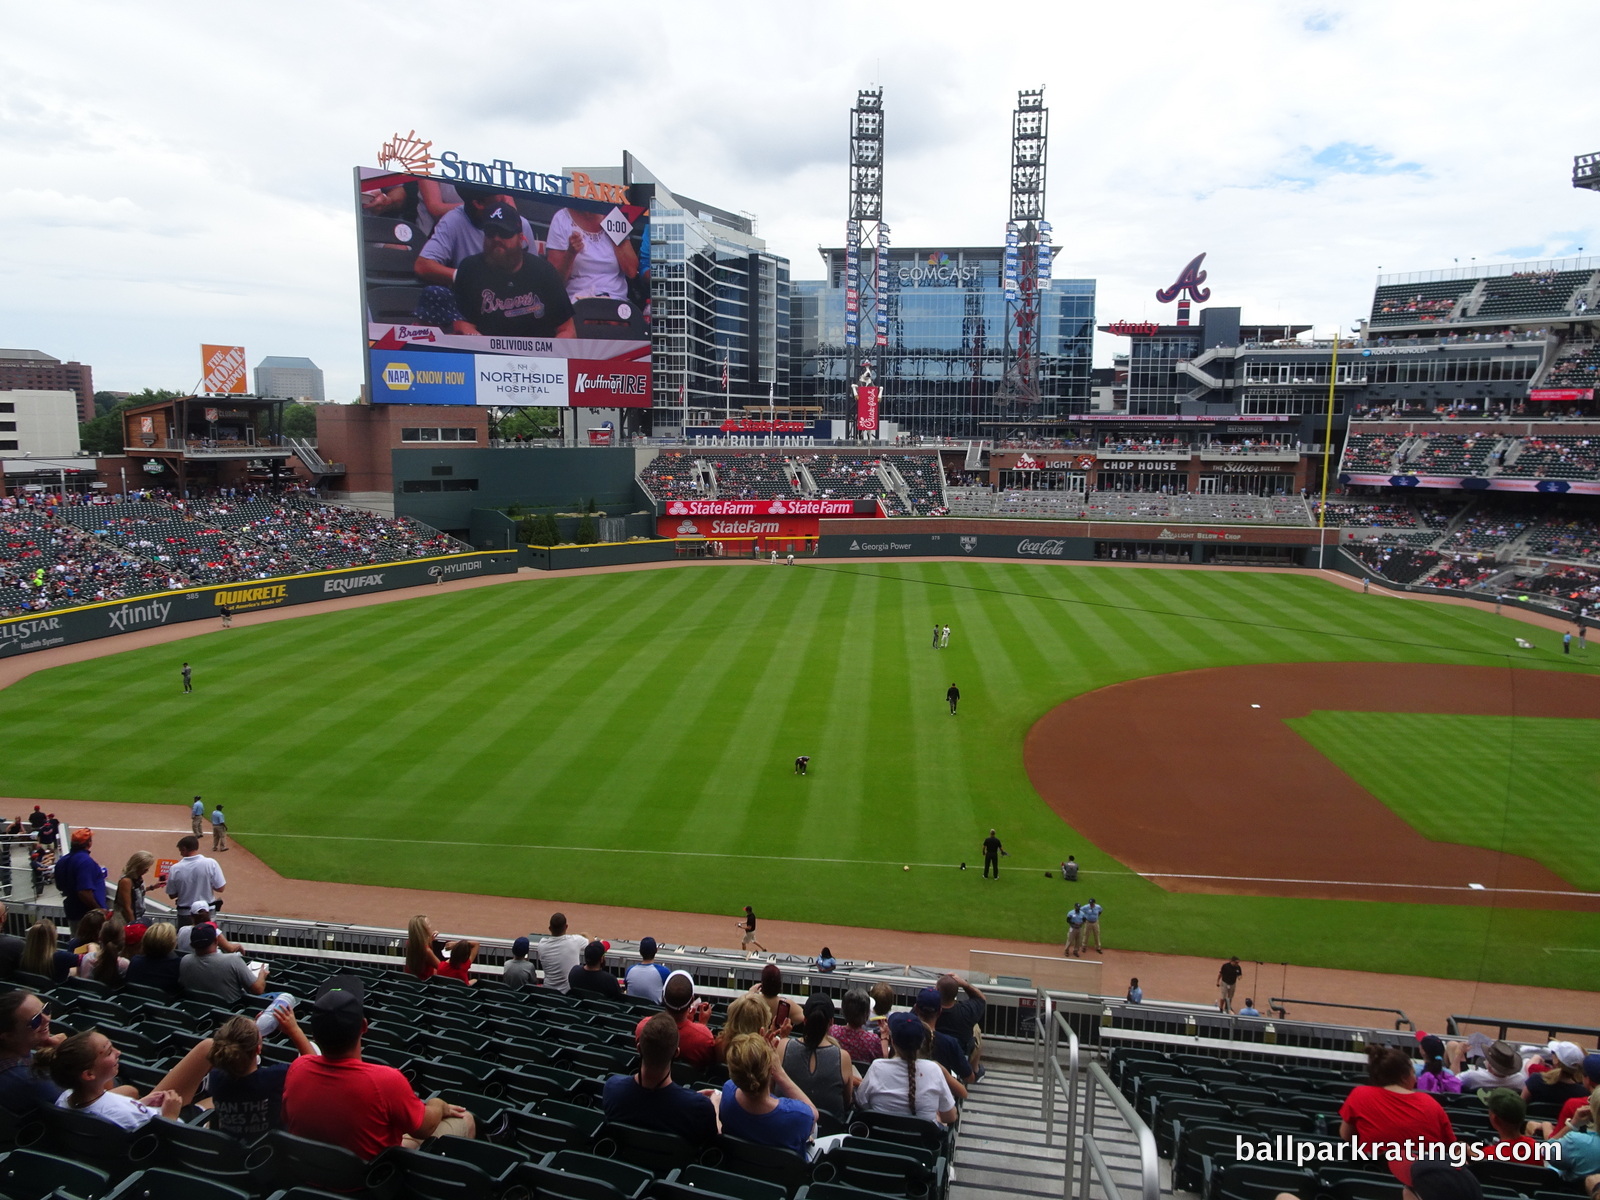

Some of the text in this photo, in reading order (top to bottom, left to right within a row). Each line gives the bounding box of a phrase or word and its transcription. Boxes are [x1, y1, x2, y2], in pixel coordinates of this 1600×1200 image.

[571, 171, 631, 205] PARK
[606, 219, 627, 234] 0:00
[898, 267, 980, 281] COMCAST
[481, 289, 534, 315] Braves
[399, 326, 429, 339] Braves
[1108, 319, 1160, 336] xfinity
[490, 339, 553, 352] OBLIVIOUS CAM
[206, 350, 225, 368] THE
[205, 347, 245, 392] HOME
[221, 364, 246, 391] DEPOT
[387, 369, 465, 385] NAPA KNOW HOW
[480, 372, 564, 384] NORTHSIDE
[574, 373, 647, 394] Kauffman TIRE
[496, 386, 550, 394] HOSPITAL
[695, 435, 815, 447] PLAY BALL ATLANTA
[1015, 457, 1072, 470] Coors LIGHT
[1103, 461, 1177, 471] CHOP HOUSE
[1223, 461, 1260, 472] Silver
[861, 542, 889, 551] Georgia
[1017, 538, 1067, 555] Coca-Cola
[444, 561, 482, 574] HYUNDAI
[323, 574, 383, 593] EQUIFAX
[186, 592, 200, 600] 385
[214, 585, 287, 606] QUIKRETE
[108, 600, 172, 631] xfinity
[21, 637, 64, 650] Health System
[242, 1099, 269, 1112] THE
